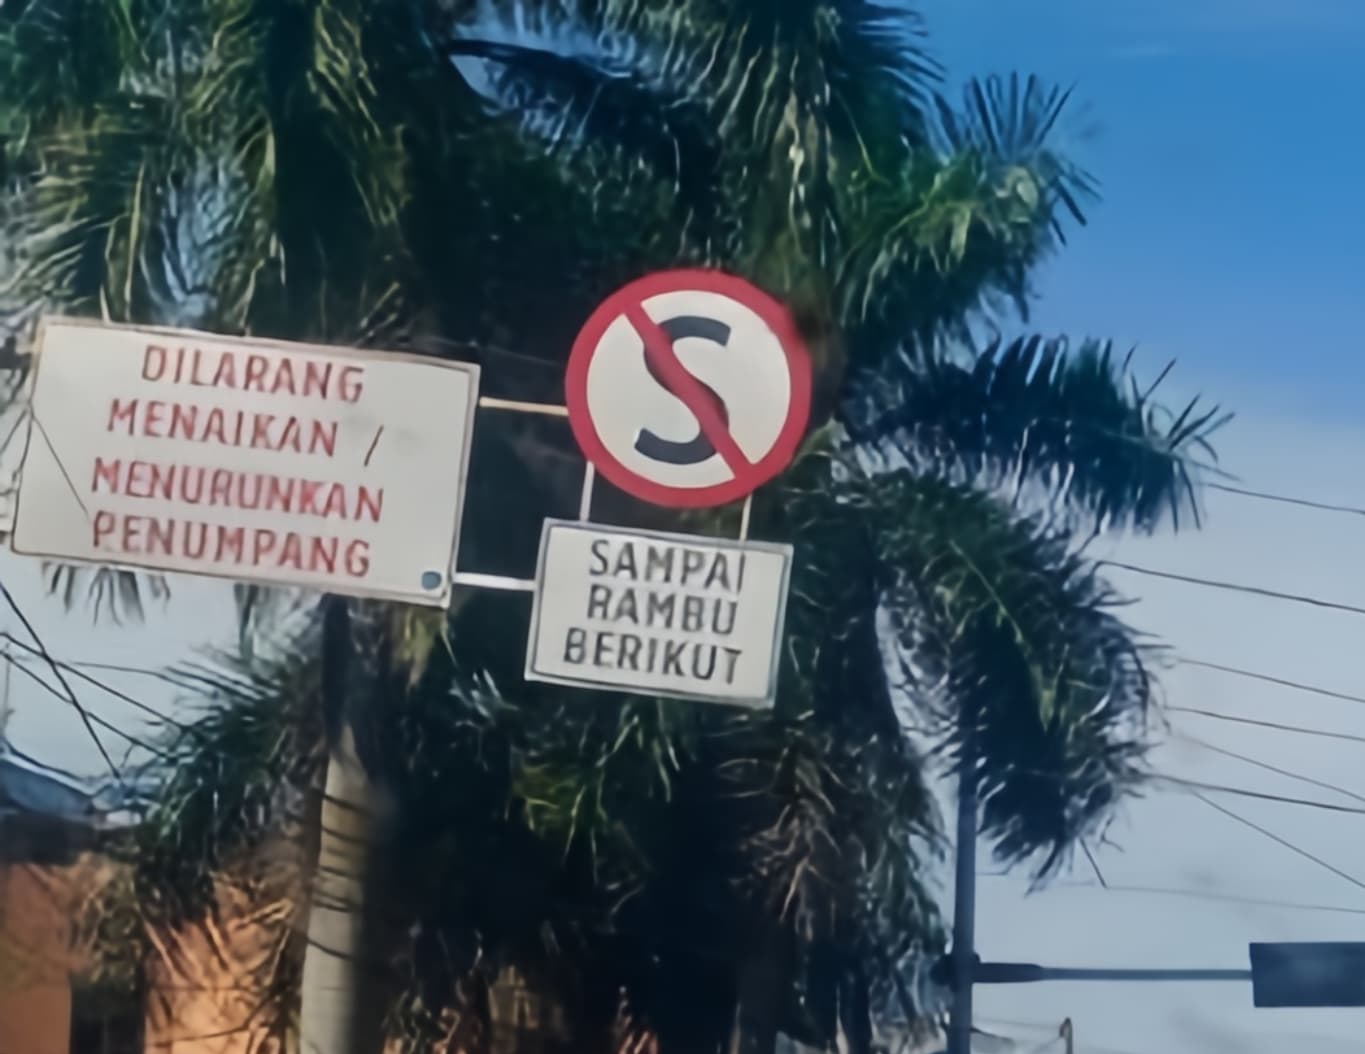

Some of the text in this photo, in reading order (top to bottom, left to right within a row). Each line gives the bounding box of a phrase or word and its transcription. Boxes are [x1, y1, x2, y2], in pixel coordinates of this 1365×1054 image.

[141, 345, 364, 404] DILARANG
[107, 398, 384, 467] MENAIKAN /
[91, 456, 384, 523] MENURUNKAN
[93, 509, 370, 578] PENUMPANG
[589, 539, 746, 593] SAMPAI
[587, 584, 738, 635] RAMBU
[563, 627, 742, 685] BERIKUT
